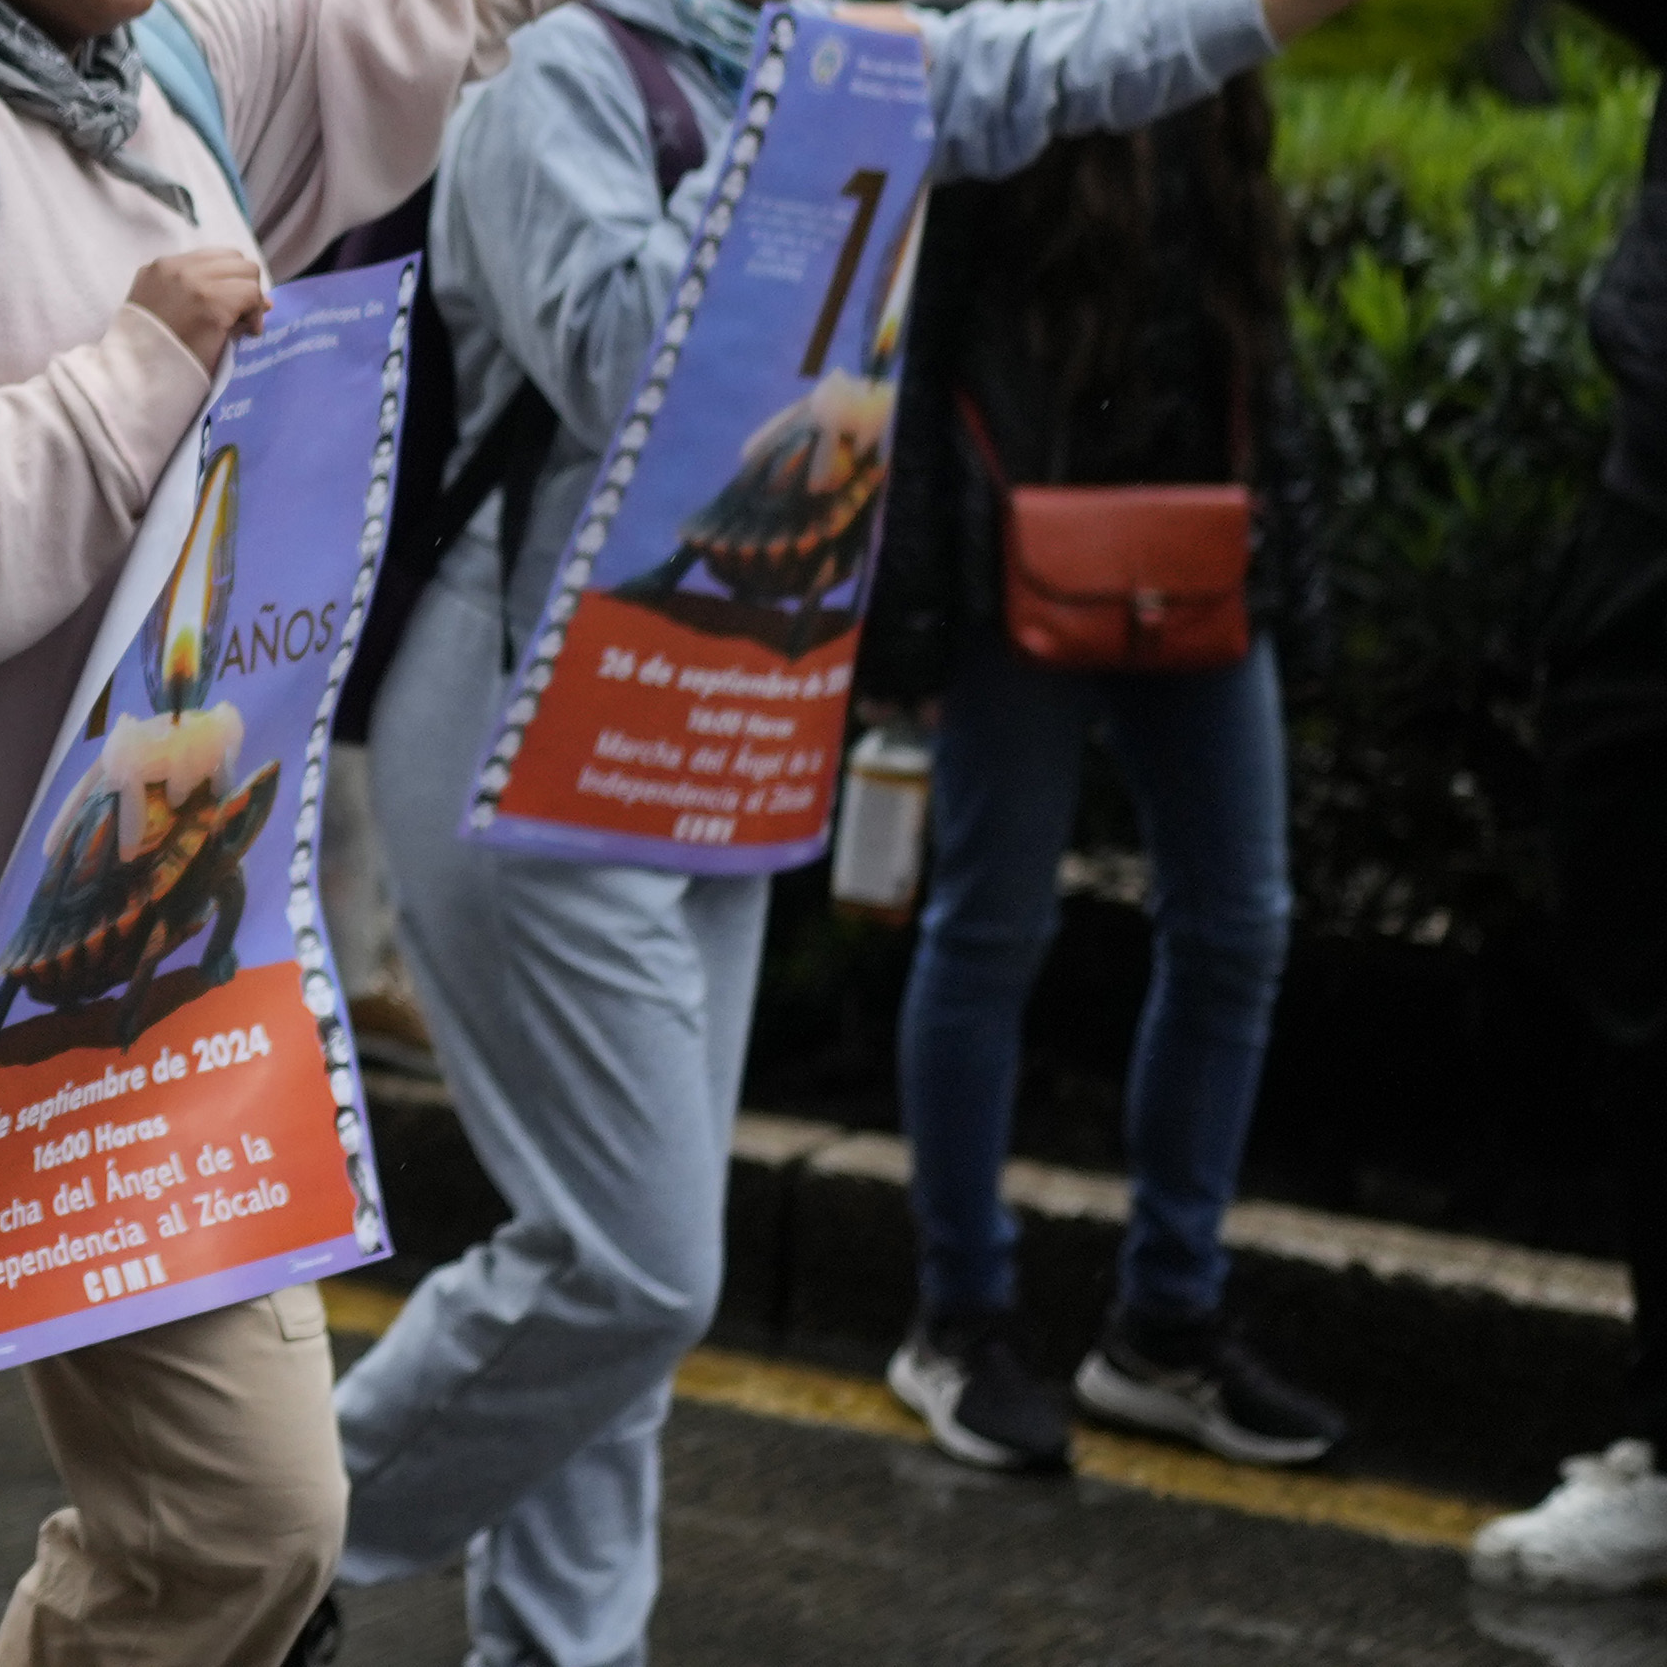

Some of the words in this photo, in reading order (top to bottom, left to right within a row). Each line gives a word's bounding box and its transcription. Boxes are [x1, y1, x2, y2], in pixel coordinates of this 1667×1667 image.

[216, 600, 337, 681] AÑOS
[14, 1064, 147, 1133] septiembre
[152, 1046, 188, 1085] de
[191, 1022, 273, 1074] 2024
[32, 1129, 92, 1173] 16:00
[95, 1114, 171, 1154] Horas
[52, 1176, 97, 1218] del
[105, 1151, 187, 1204] Ángel
[195, 1143, 235, 1178] de
[240, 1133, 276, 1165] la
[156, 1201, 189, 1239] al
[192, 1175, 291, 1228] Zócalo
[81, 1253, 170, 1304] CDMX
